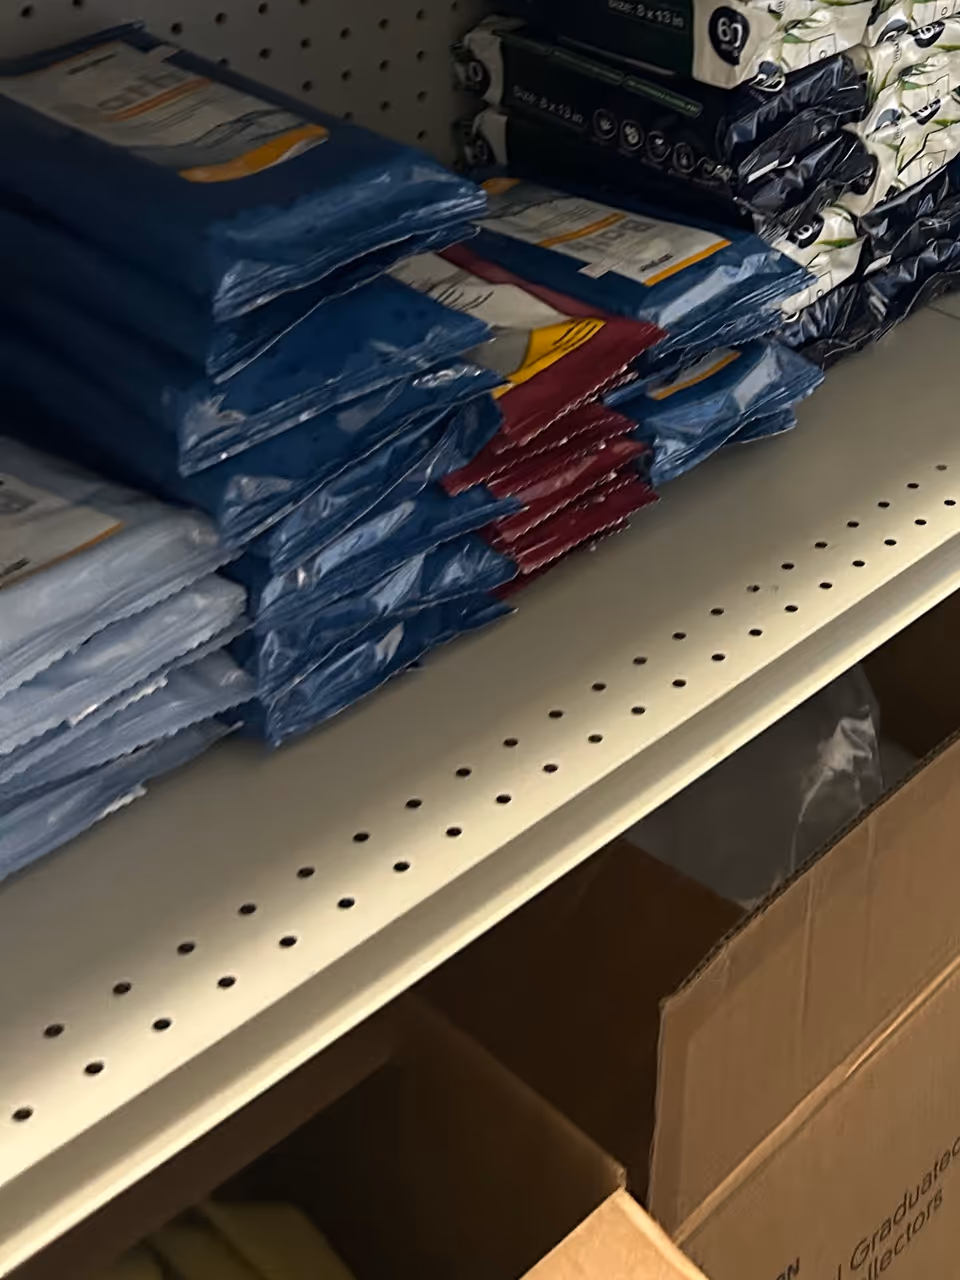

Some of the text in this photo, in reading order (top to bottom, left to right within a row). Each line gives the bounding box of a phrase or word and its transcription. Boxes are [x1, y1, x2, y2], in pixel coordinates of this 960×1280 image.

[655, 10, 671, 26] 13
[671, 15, 685, 28] in
[572, 111, 585, 124] in
